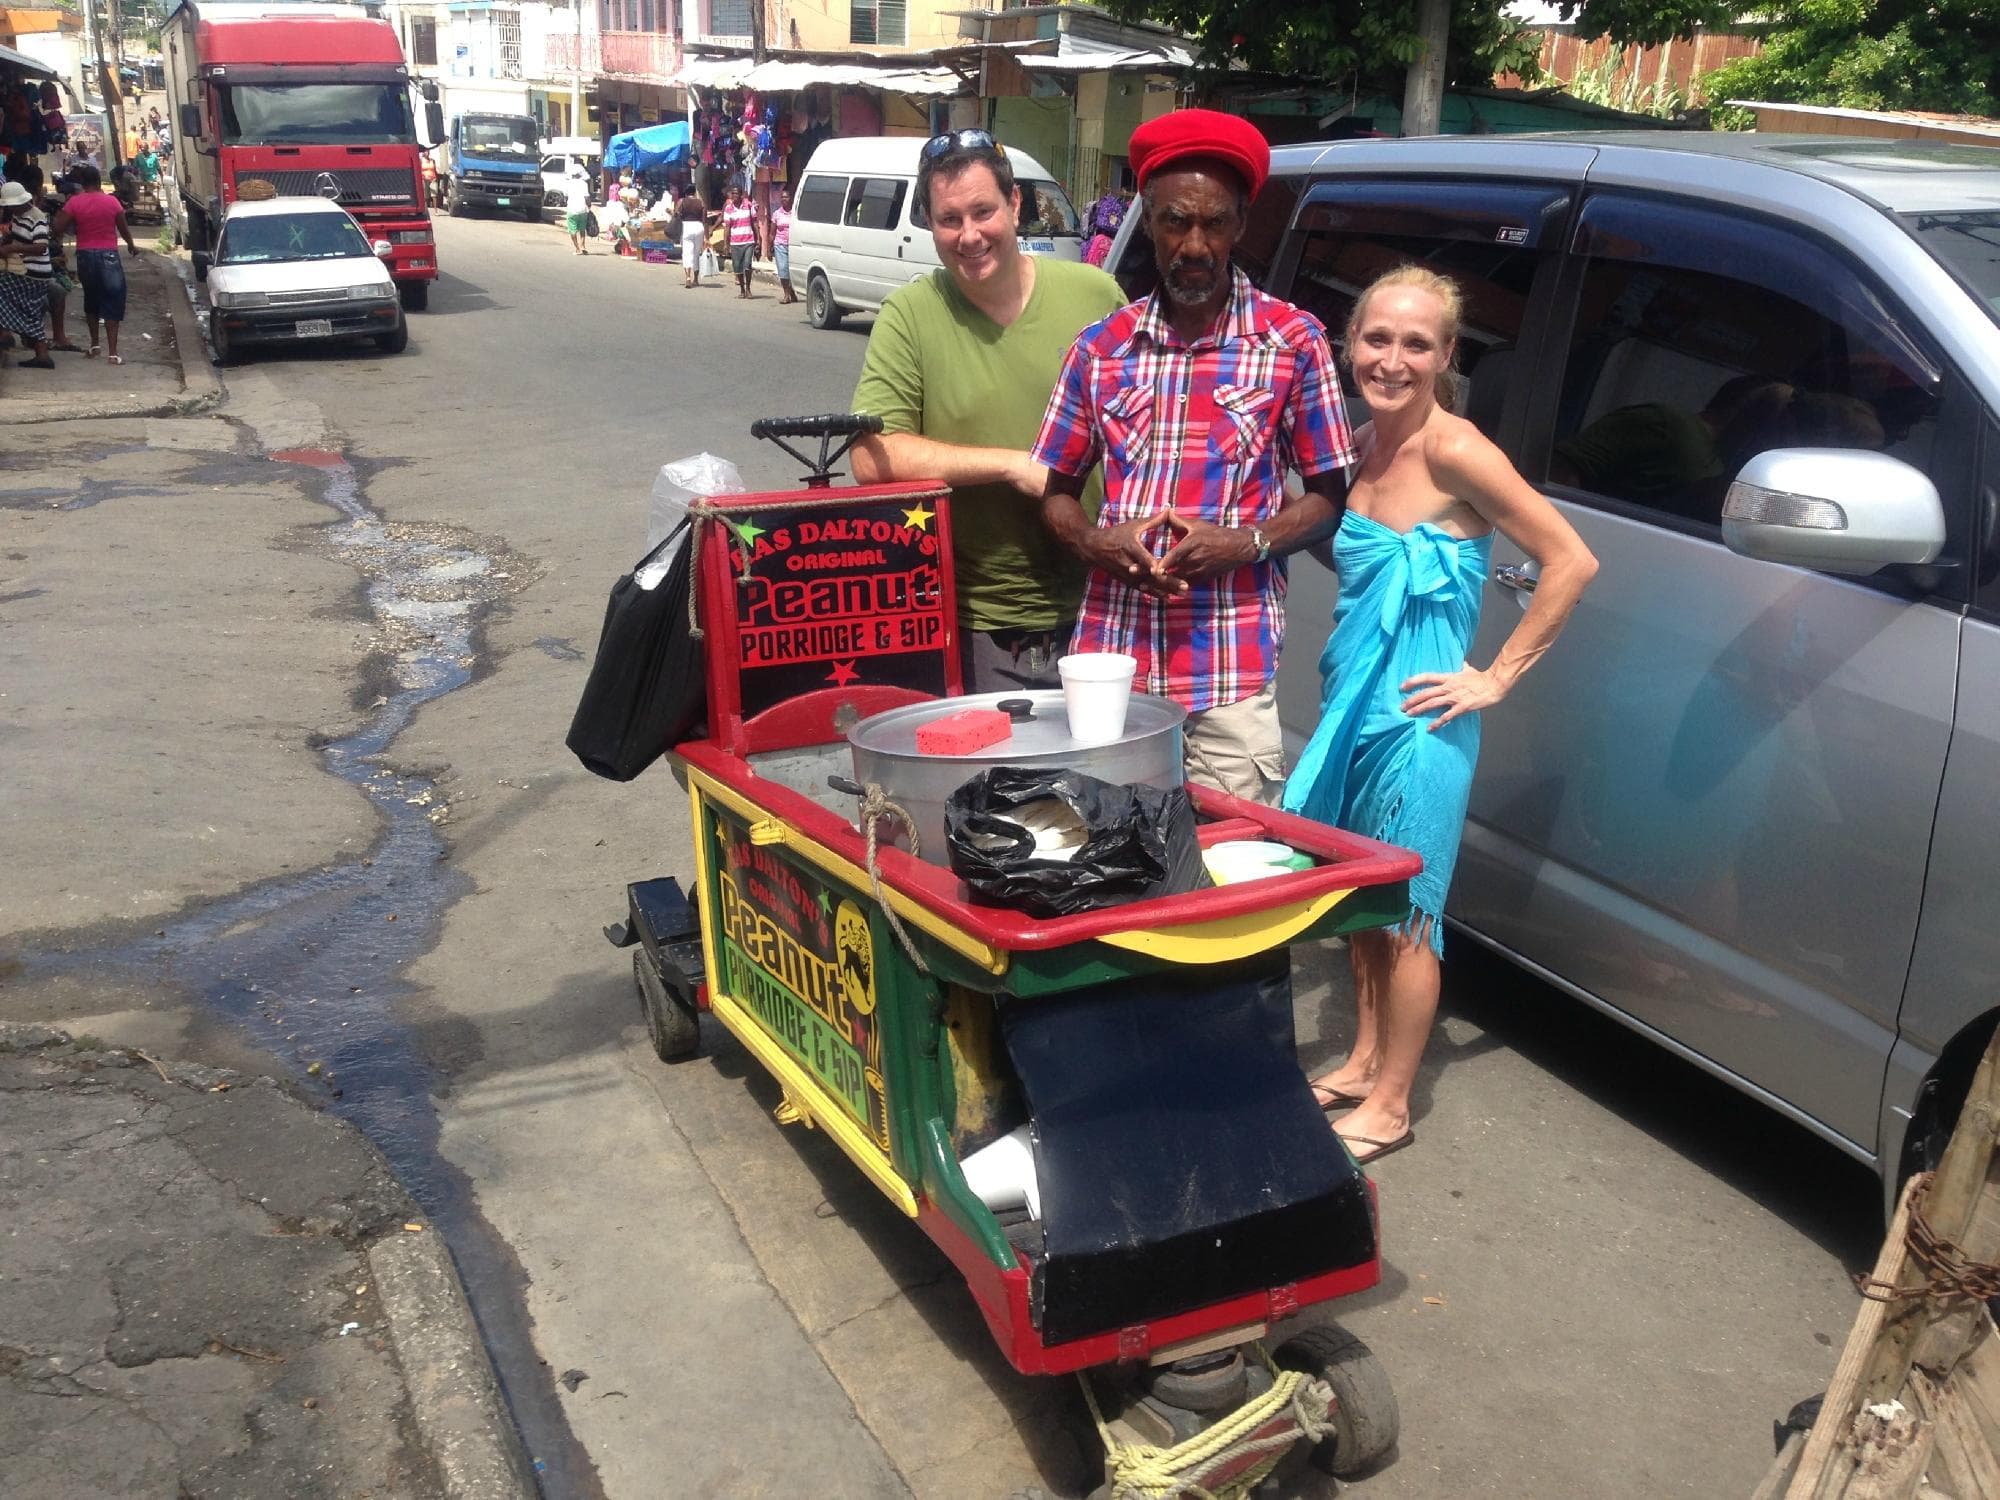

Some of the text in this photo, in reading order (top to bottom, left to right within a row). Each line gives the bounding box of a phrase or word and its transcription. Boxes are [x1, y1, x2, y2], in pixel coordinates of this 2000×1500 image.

[786, 549, 888, 571] ORIGINAL
[798, 518, 939, 556] DALTON'S
[736, 563, 941, 627] Peanut
[741, 616, 940, 662] PORRIDGE & SIP
[749, 875, 802, 935] ORIGINAL
[754, 847, 829, 948] DALTON'S
[719, 869, 853, 1045] Peanut
[729, 945, 861, 1107] PORRIDGE & SIP
